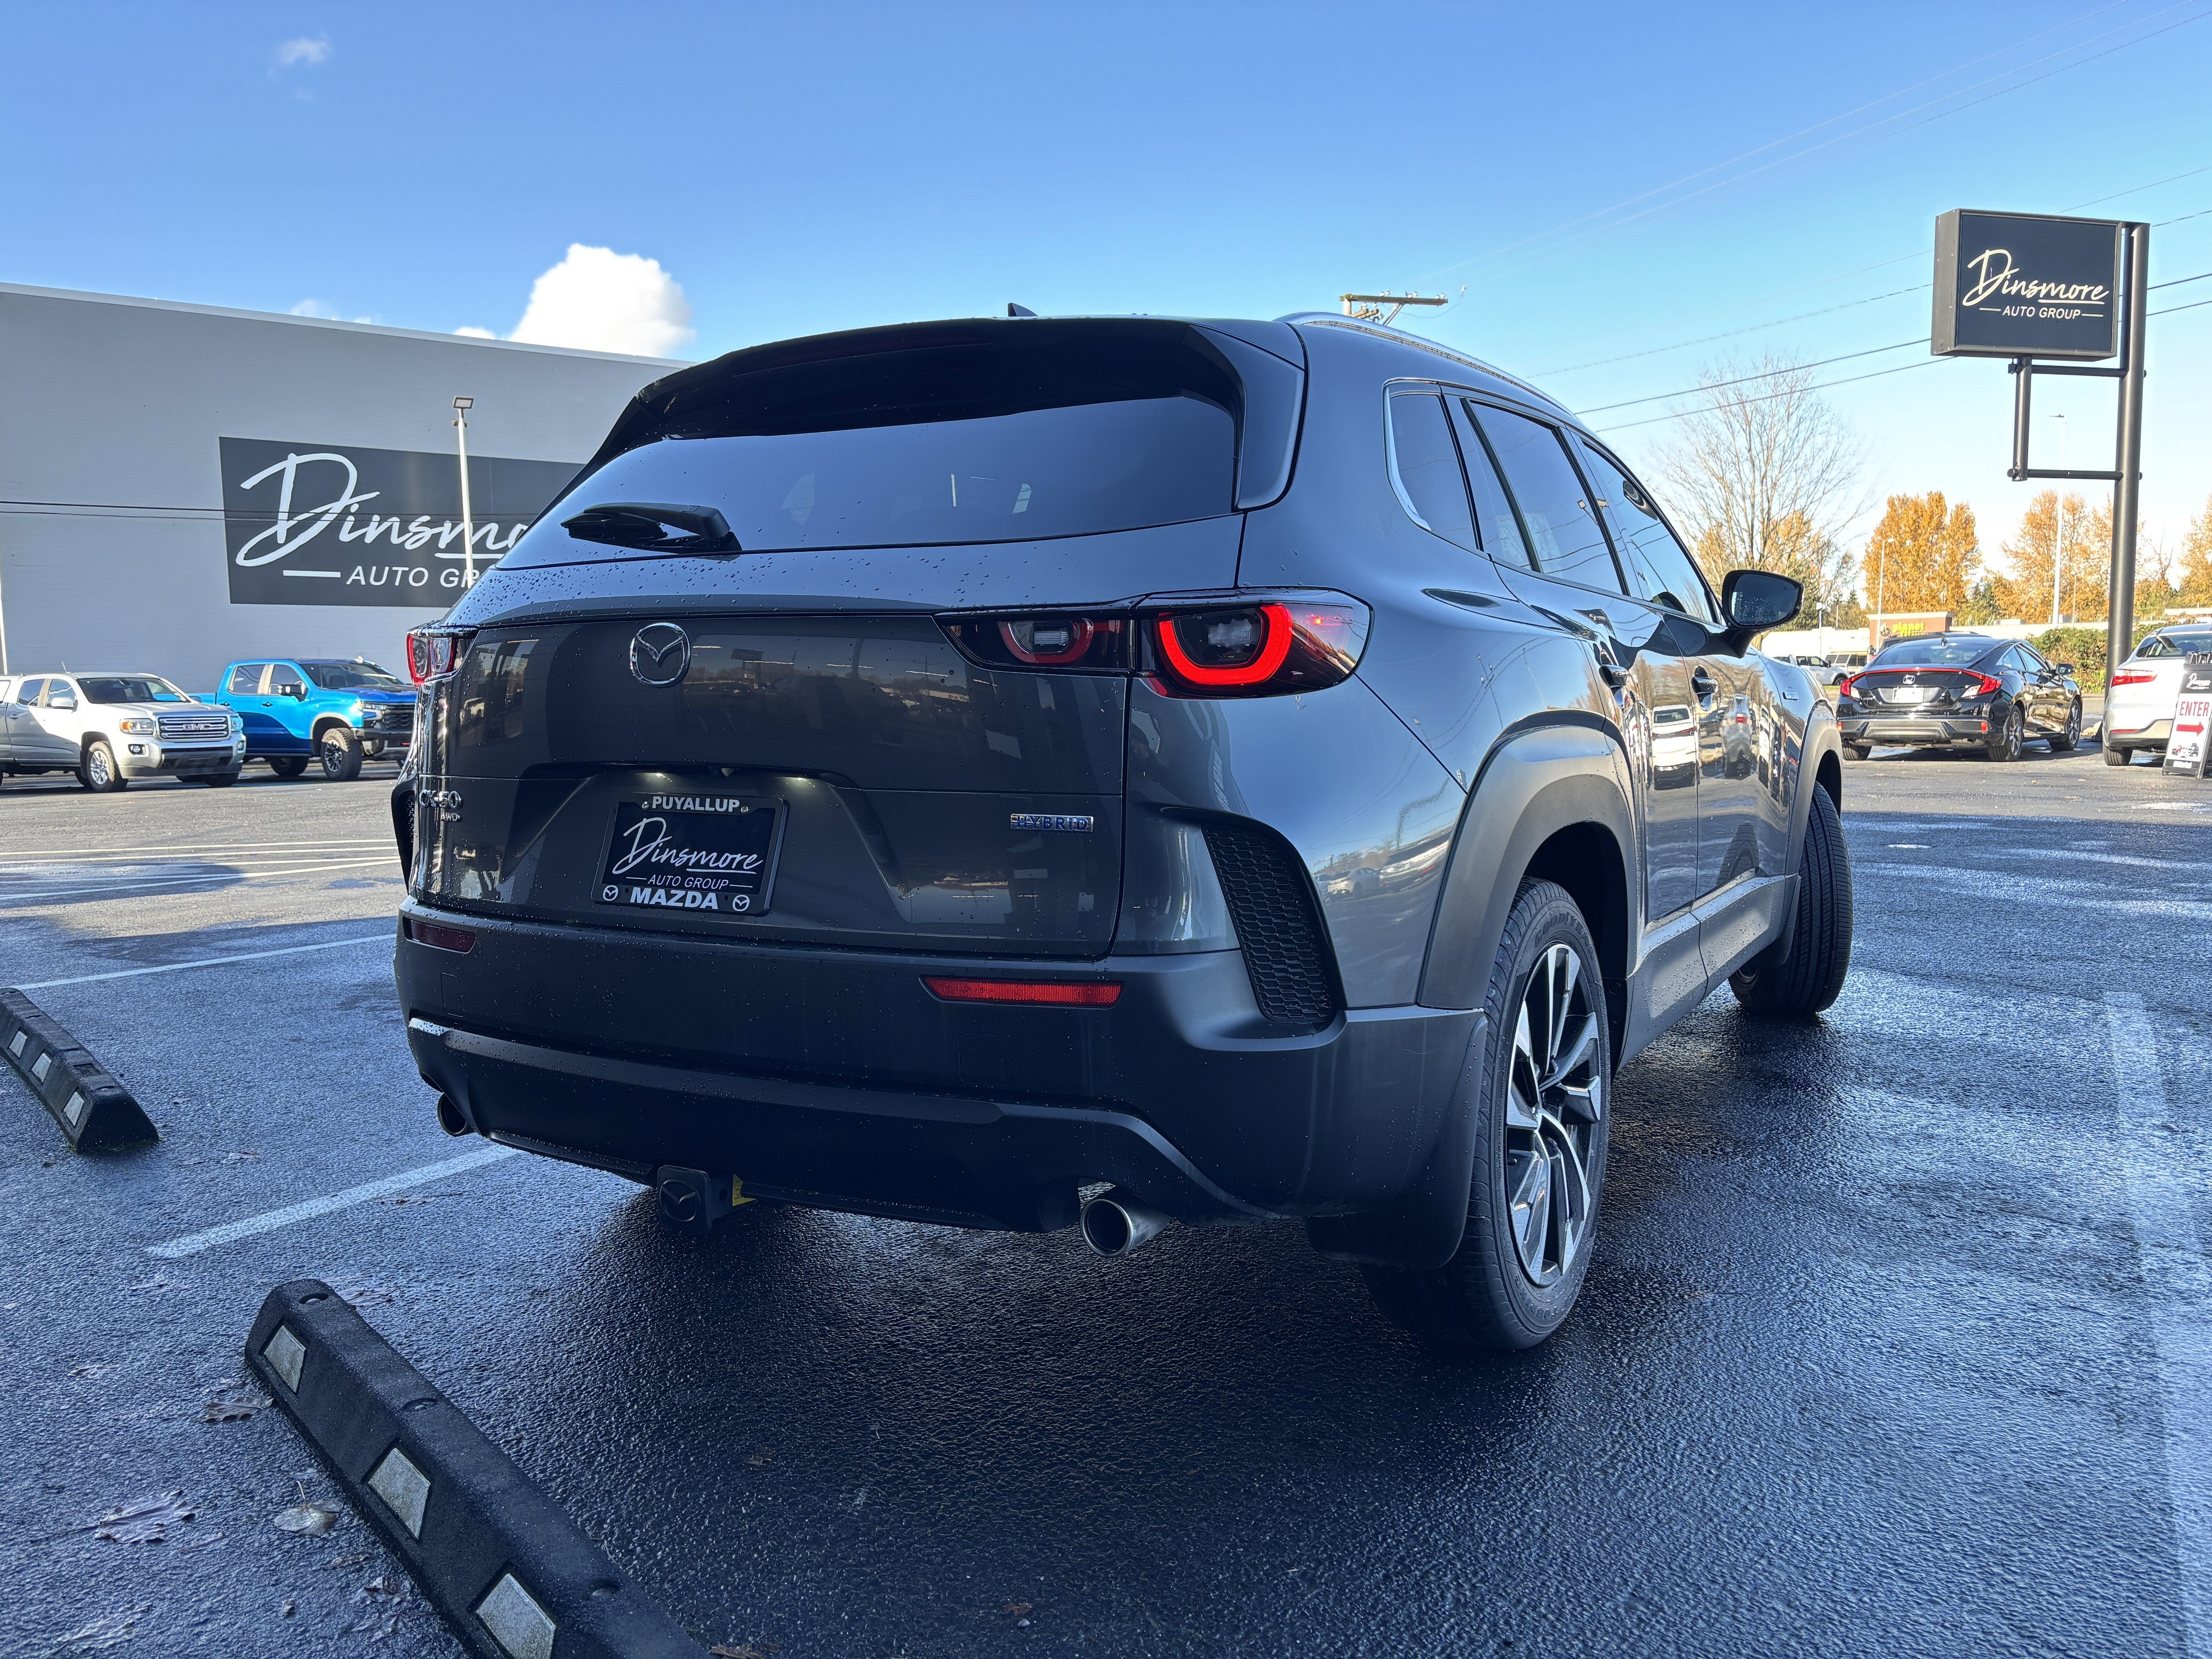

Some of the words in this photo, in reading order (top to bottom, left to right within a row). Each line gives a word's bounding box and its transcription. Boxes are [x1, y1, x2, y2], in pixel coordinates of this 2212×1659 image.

[1962, 249, 2109, 306] Dinsmore
[2002, 305, 2035, 317] AUTO
[2039, 307, 2081, 319] GROUP
[346, 565, 429, 586] AUTO
[2179, 701, 2210, 716] ENTER
[419, 789, 462, 809] CX-50
[652, 796, 740, 812] PUYALLUP
[441, 812, 460, 822] AWD
[1017, 815, 1089, 831] HYBRID
[612, 817, 763, 874] Dinsmore
[647, 874, 681, 886] AUTO
[685, 877, 729, 890] GROUP
[630, 887, 718, 910] MAZDA
